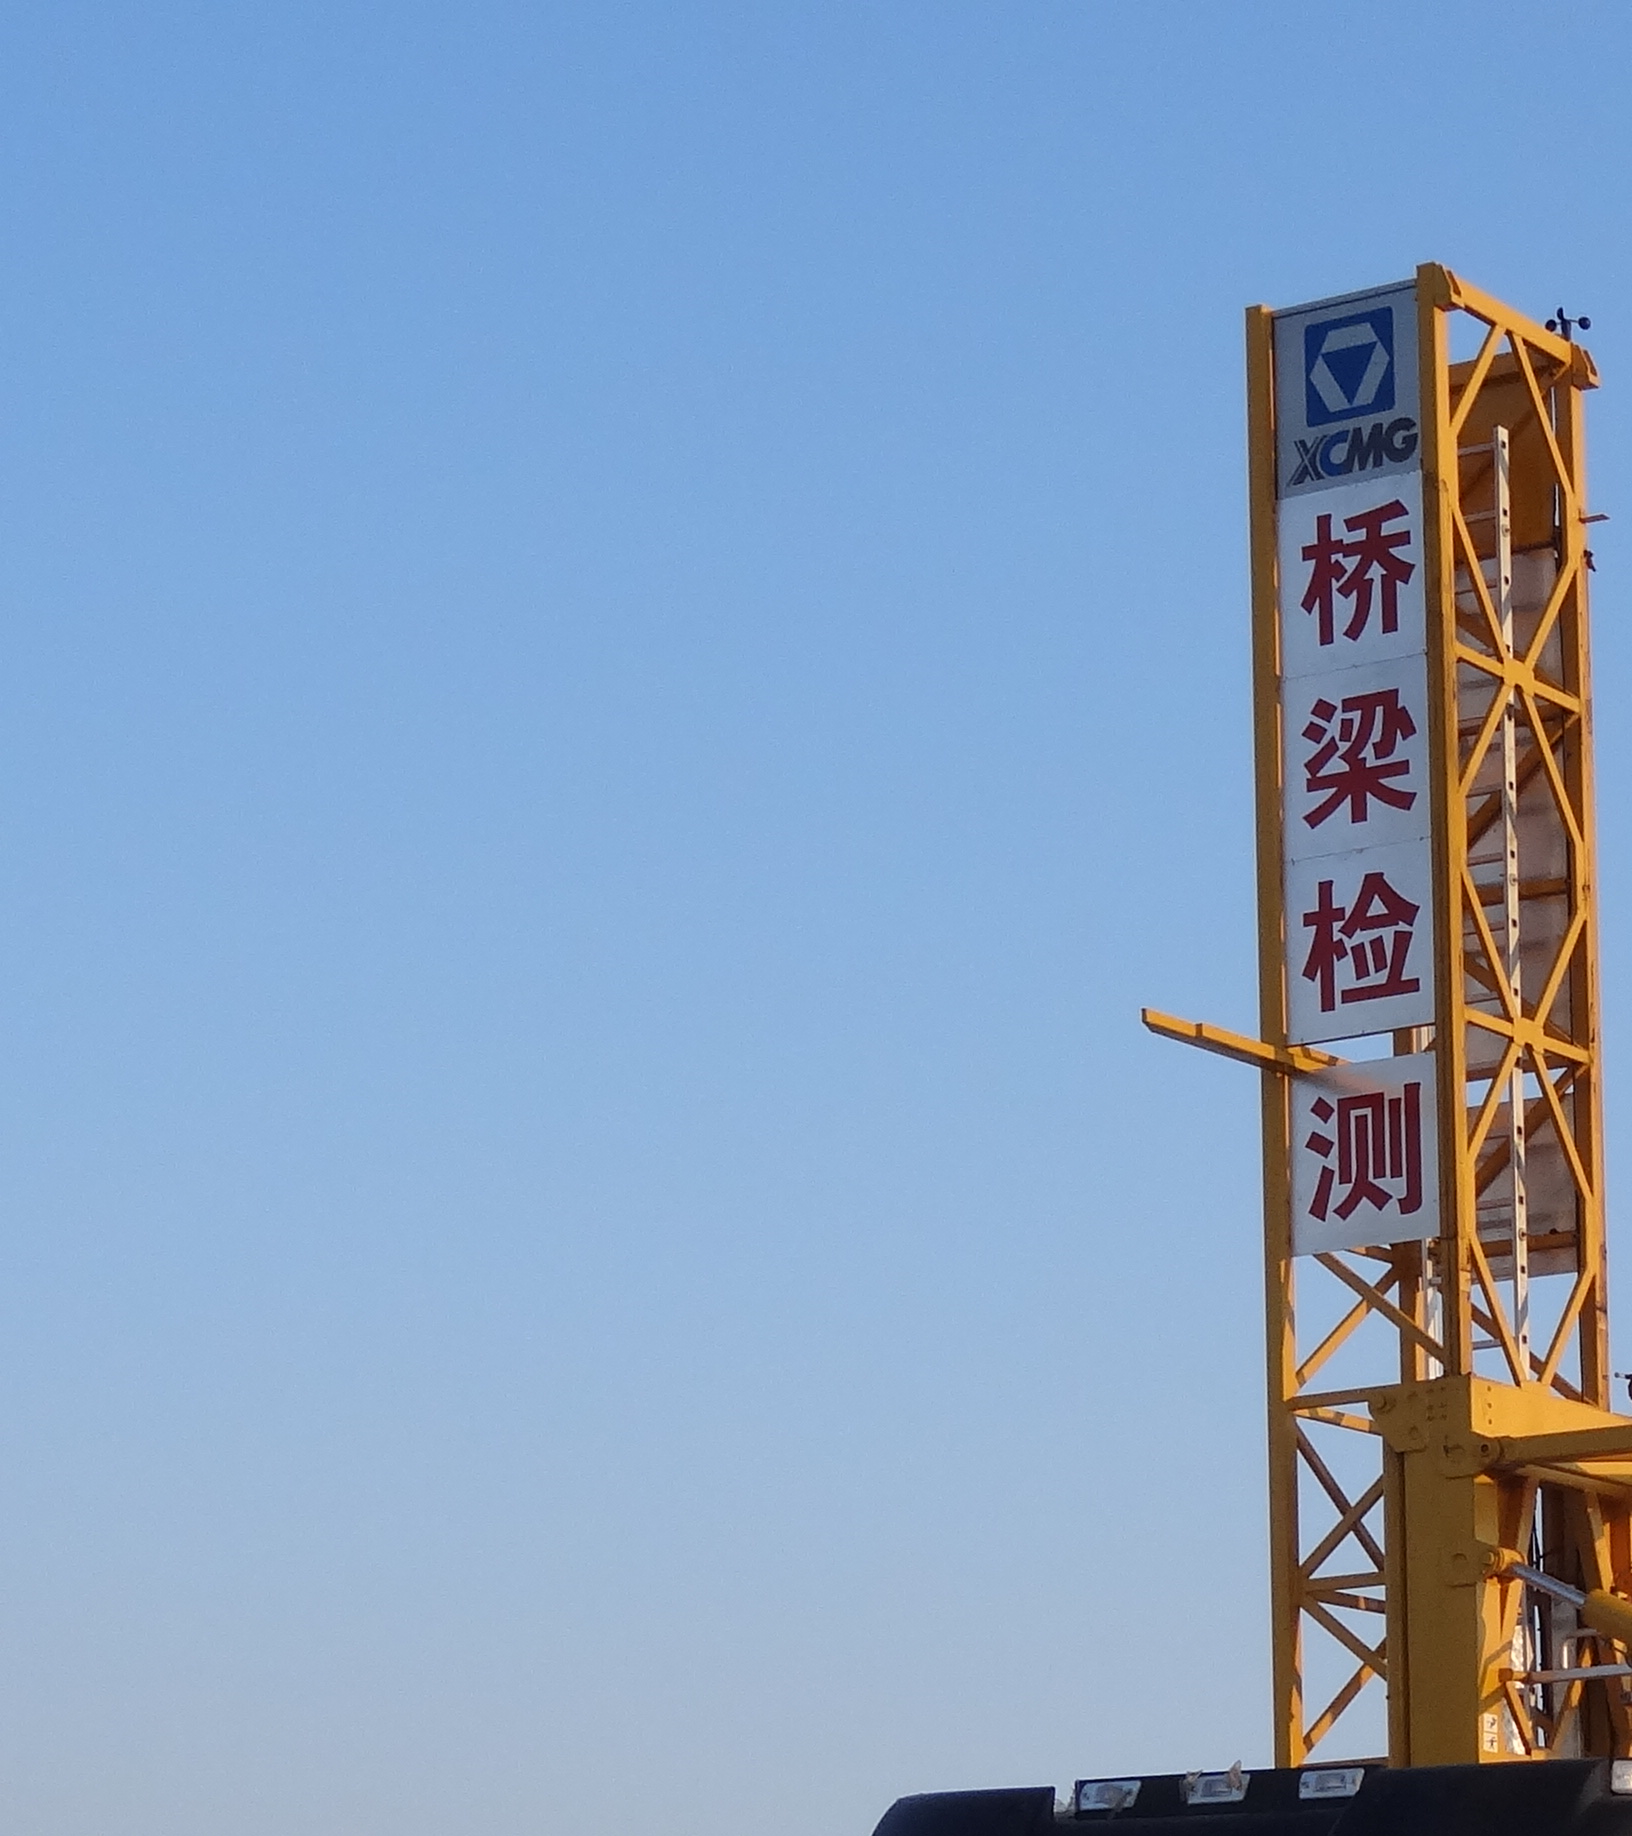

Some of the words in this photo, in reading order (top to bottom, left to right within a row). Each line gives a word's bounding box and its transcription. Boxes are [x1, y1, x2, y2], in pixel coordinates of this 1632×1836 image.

[1287, 416, 1419, 487] XCMG
[1300, 498, 1424, 1224] 桥梁检测
